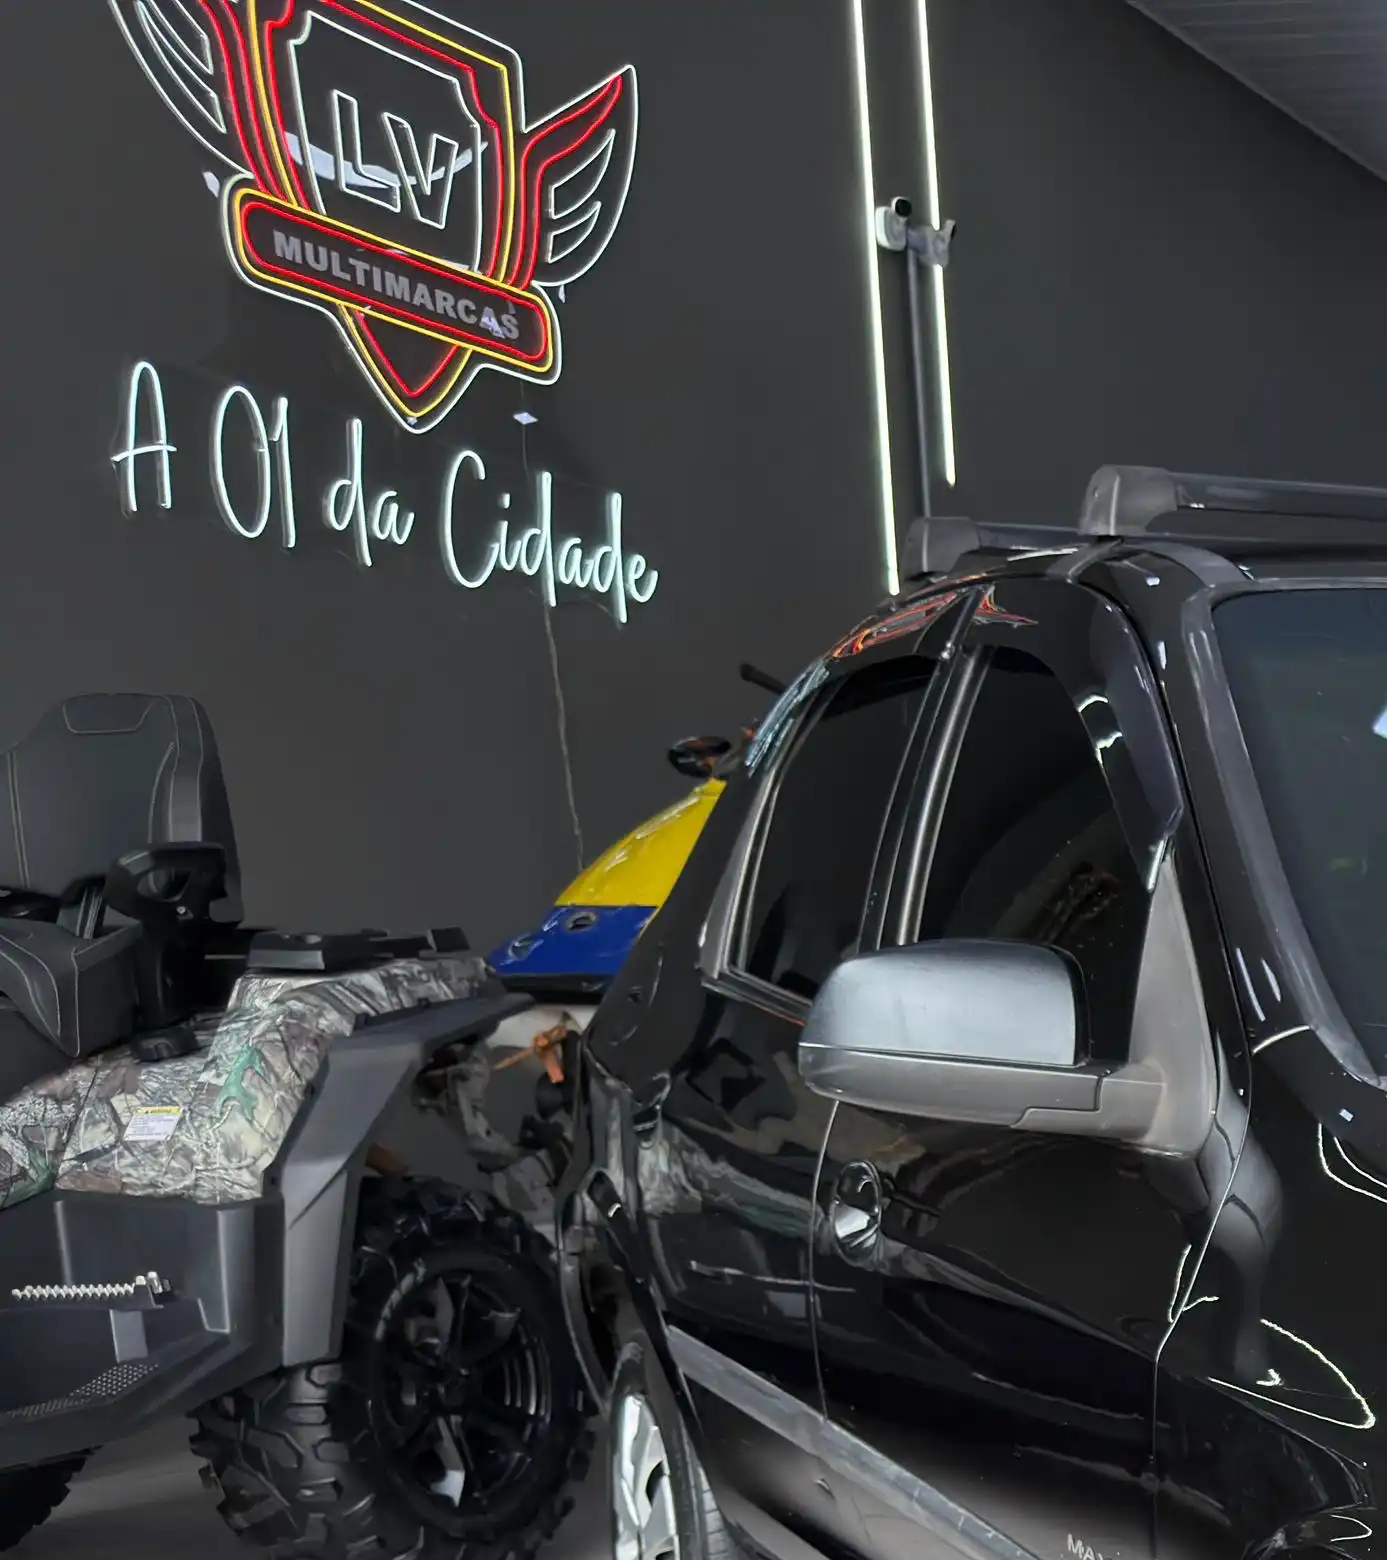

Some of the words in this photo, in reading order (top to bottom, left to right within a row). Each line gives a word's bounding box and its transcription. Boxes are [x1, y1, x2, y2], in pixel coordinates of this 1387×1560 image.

[332, 88, 459, 229] LV
[272, 229, 520, 341] MULTIMARCAS
[111, 360, 176, 512] A
[322, 418, 415, 567] da
[440, 450, 658, 625] Cidade
